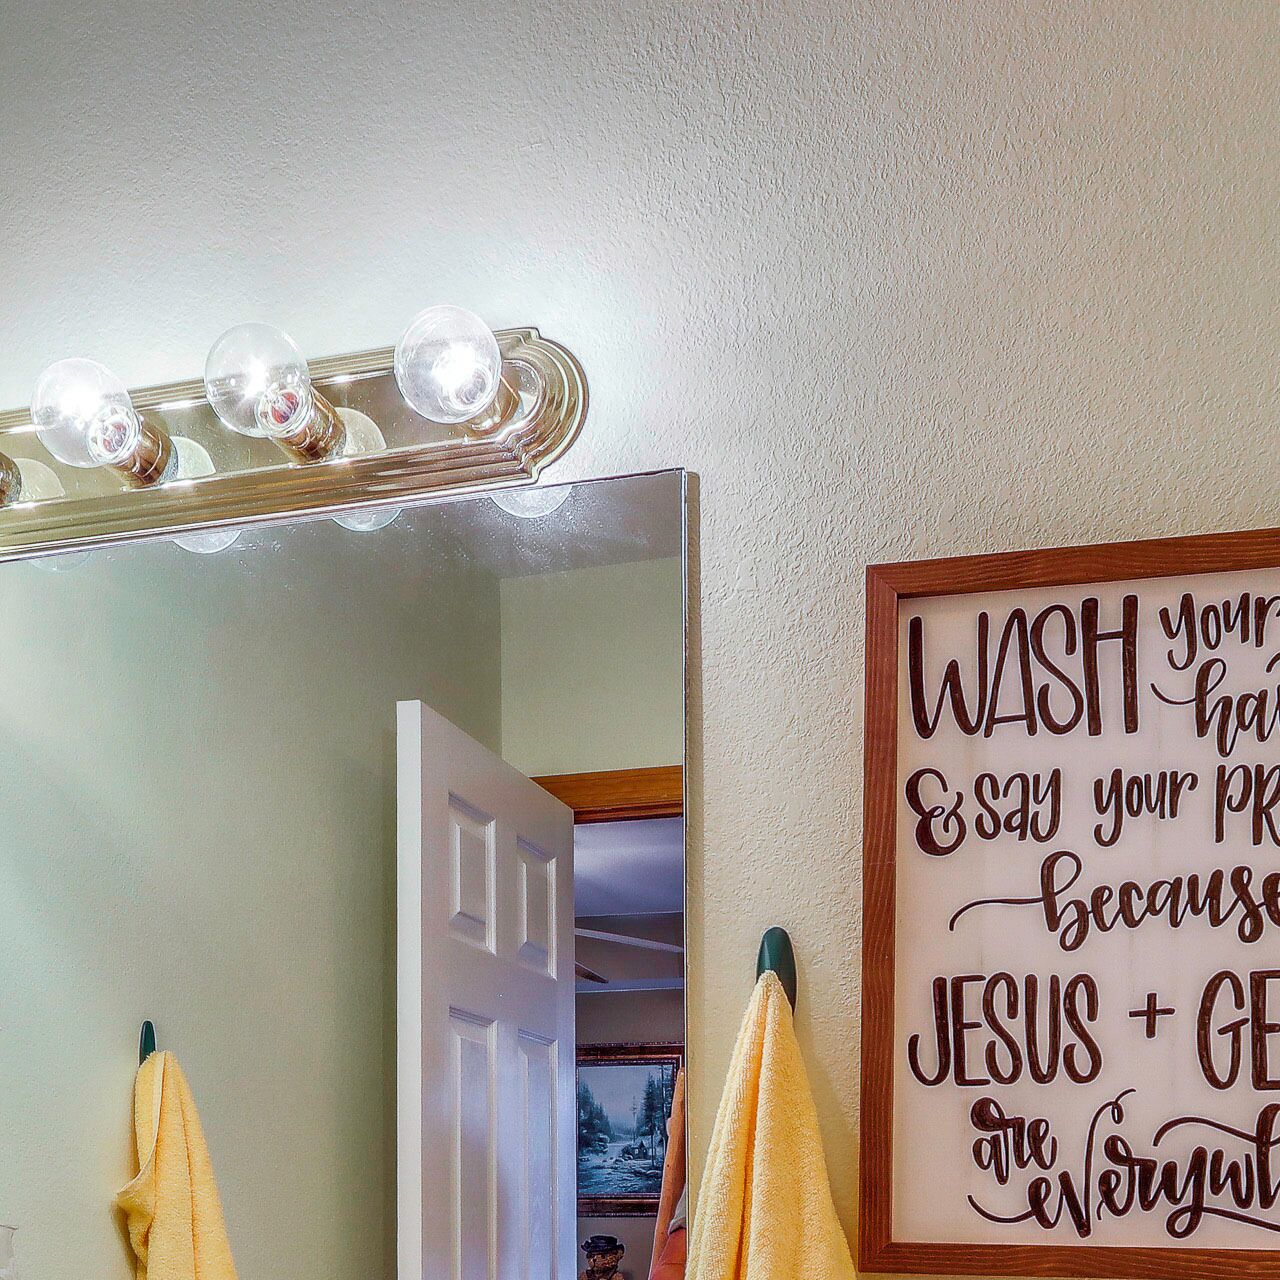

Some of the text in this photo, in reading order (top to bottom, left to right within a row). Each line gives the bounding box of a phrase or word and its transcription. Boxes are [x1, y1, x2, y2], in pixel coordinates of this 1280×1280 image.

[907, 593, 1139, 740] WASH
[905, 767, 967, 857] &
[973, 767, 1062, 844] say
[1093, 768, 1199, 848] your
[907, 973, 1103, 1087] JESUS
[970, 1096, 1058, 1186] are
